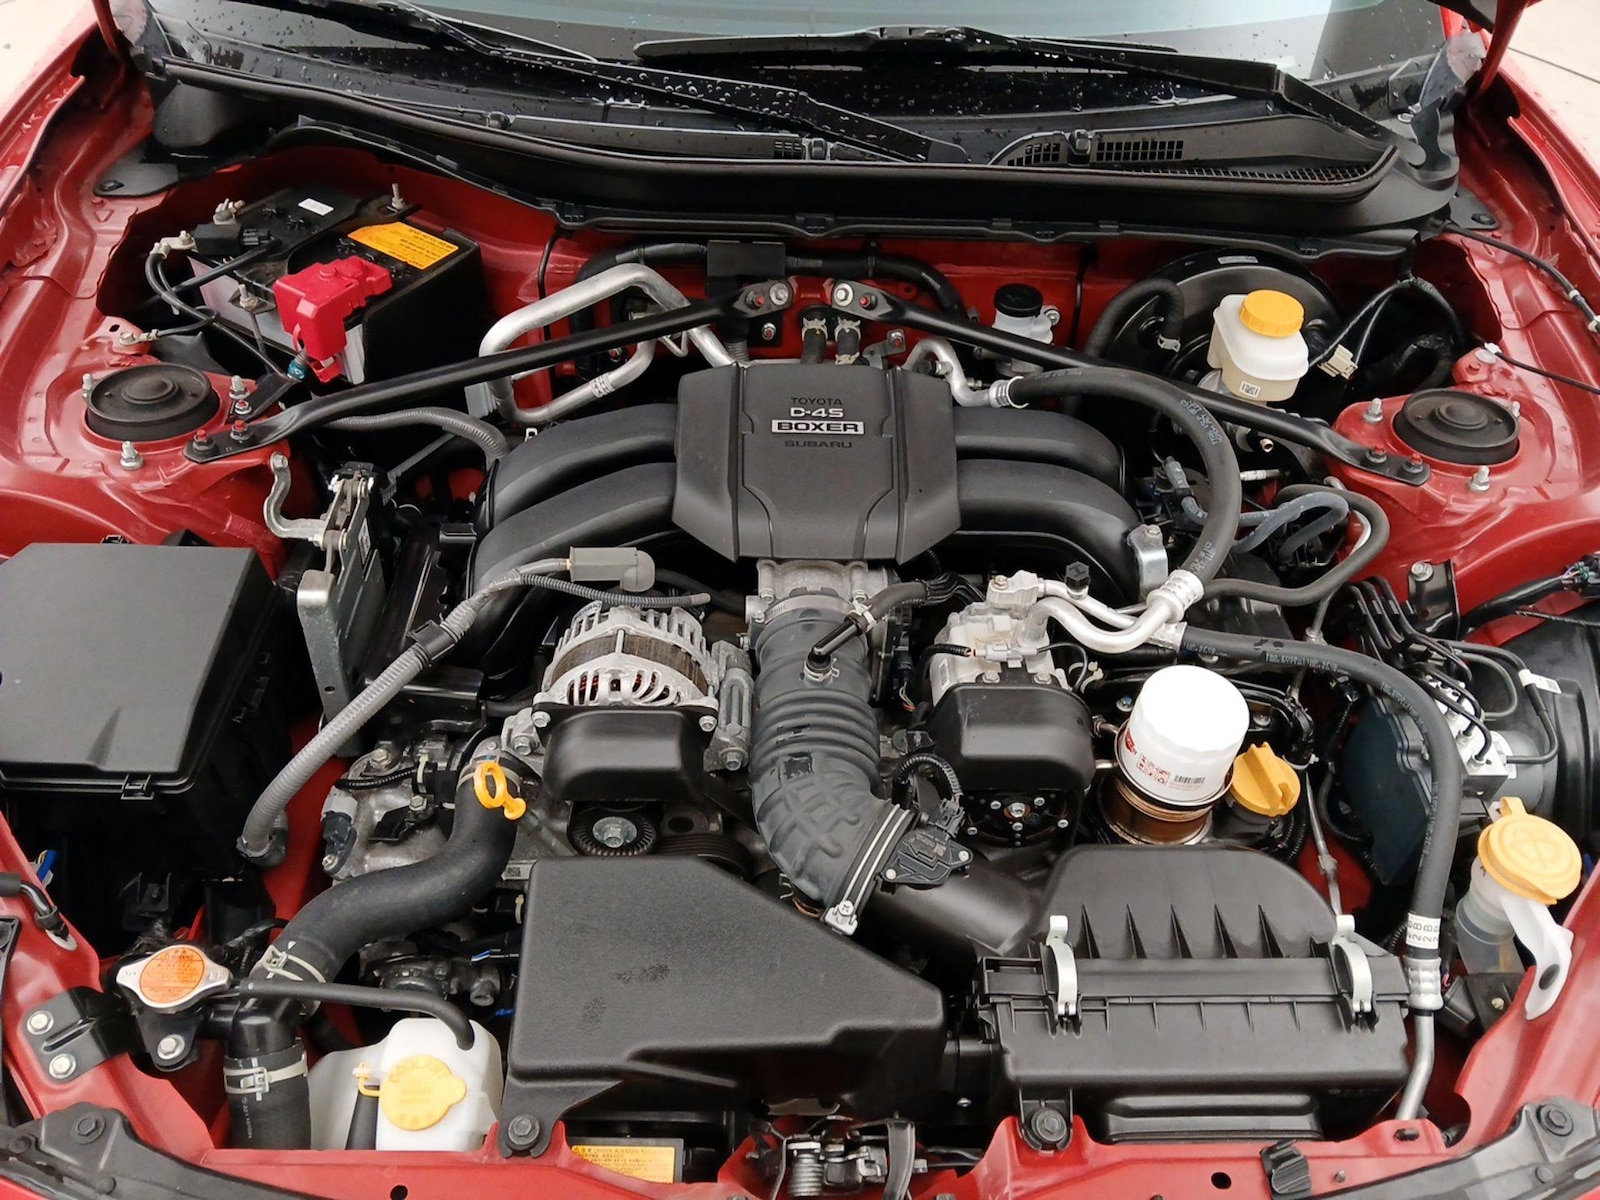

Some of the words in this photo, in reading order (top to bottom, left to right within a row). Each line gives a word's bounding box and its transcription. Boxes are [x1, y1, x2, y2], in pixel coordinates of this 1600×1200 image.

[791, 397, 843, 406] TOYOTA
[790, 407, 844, 418] D-4S
[777, 421, 859, 432] BOXER
[784, 440, 852, 448] SUBARU
